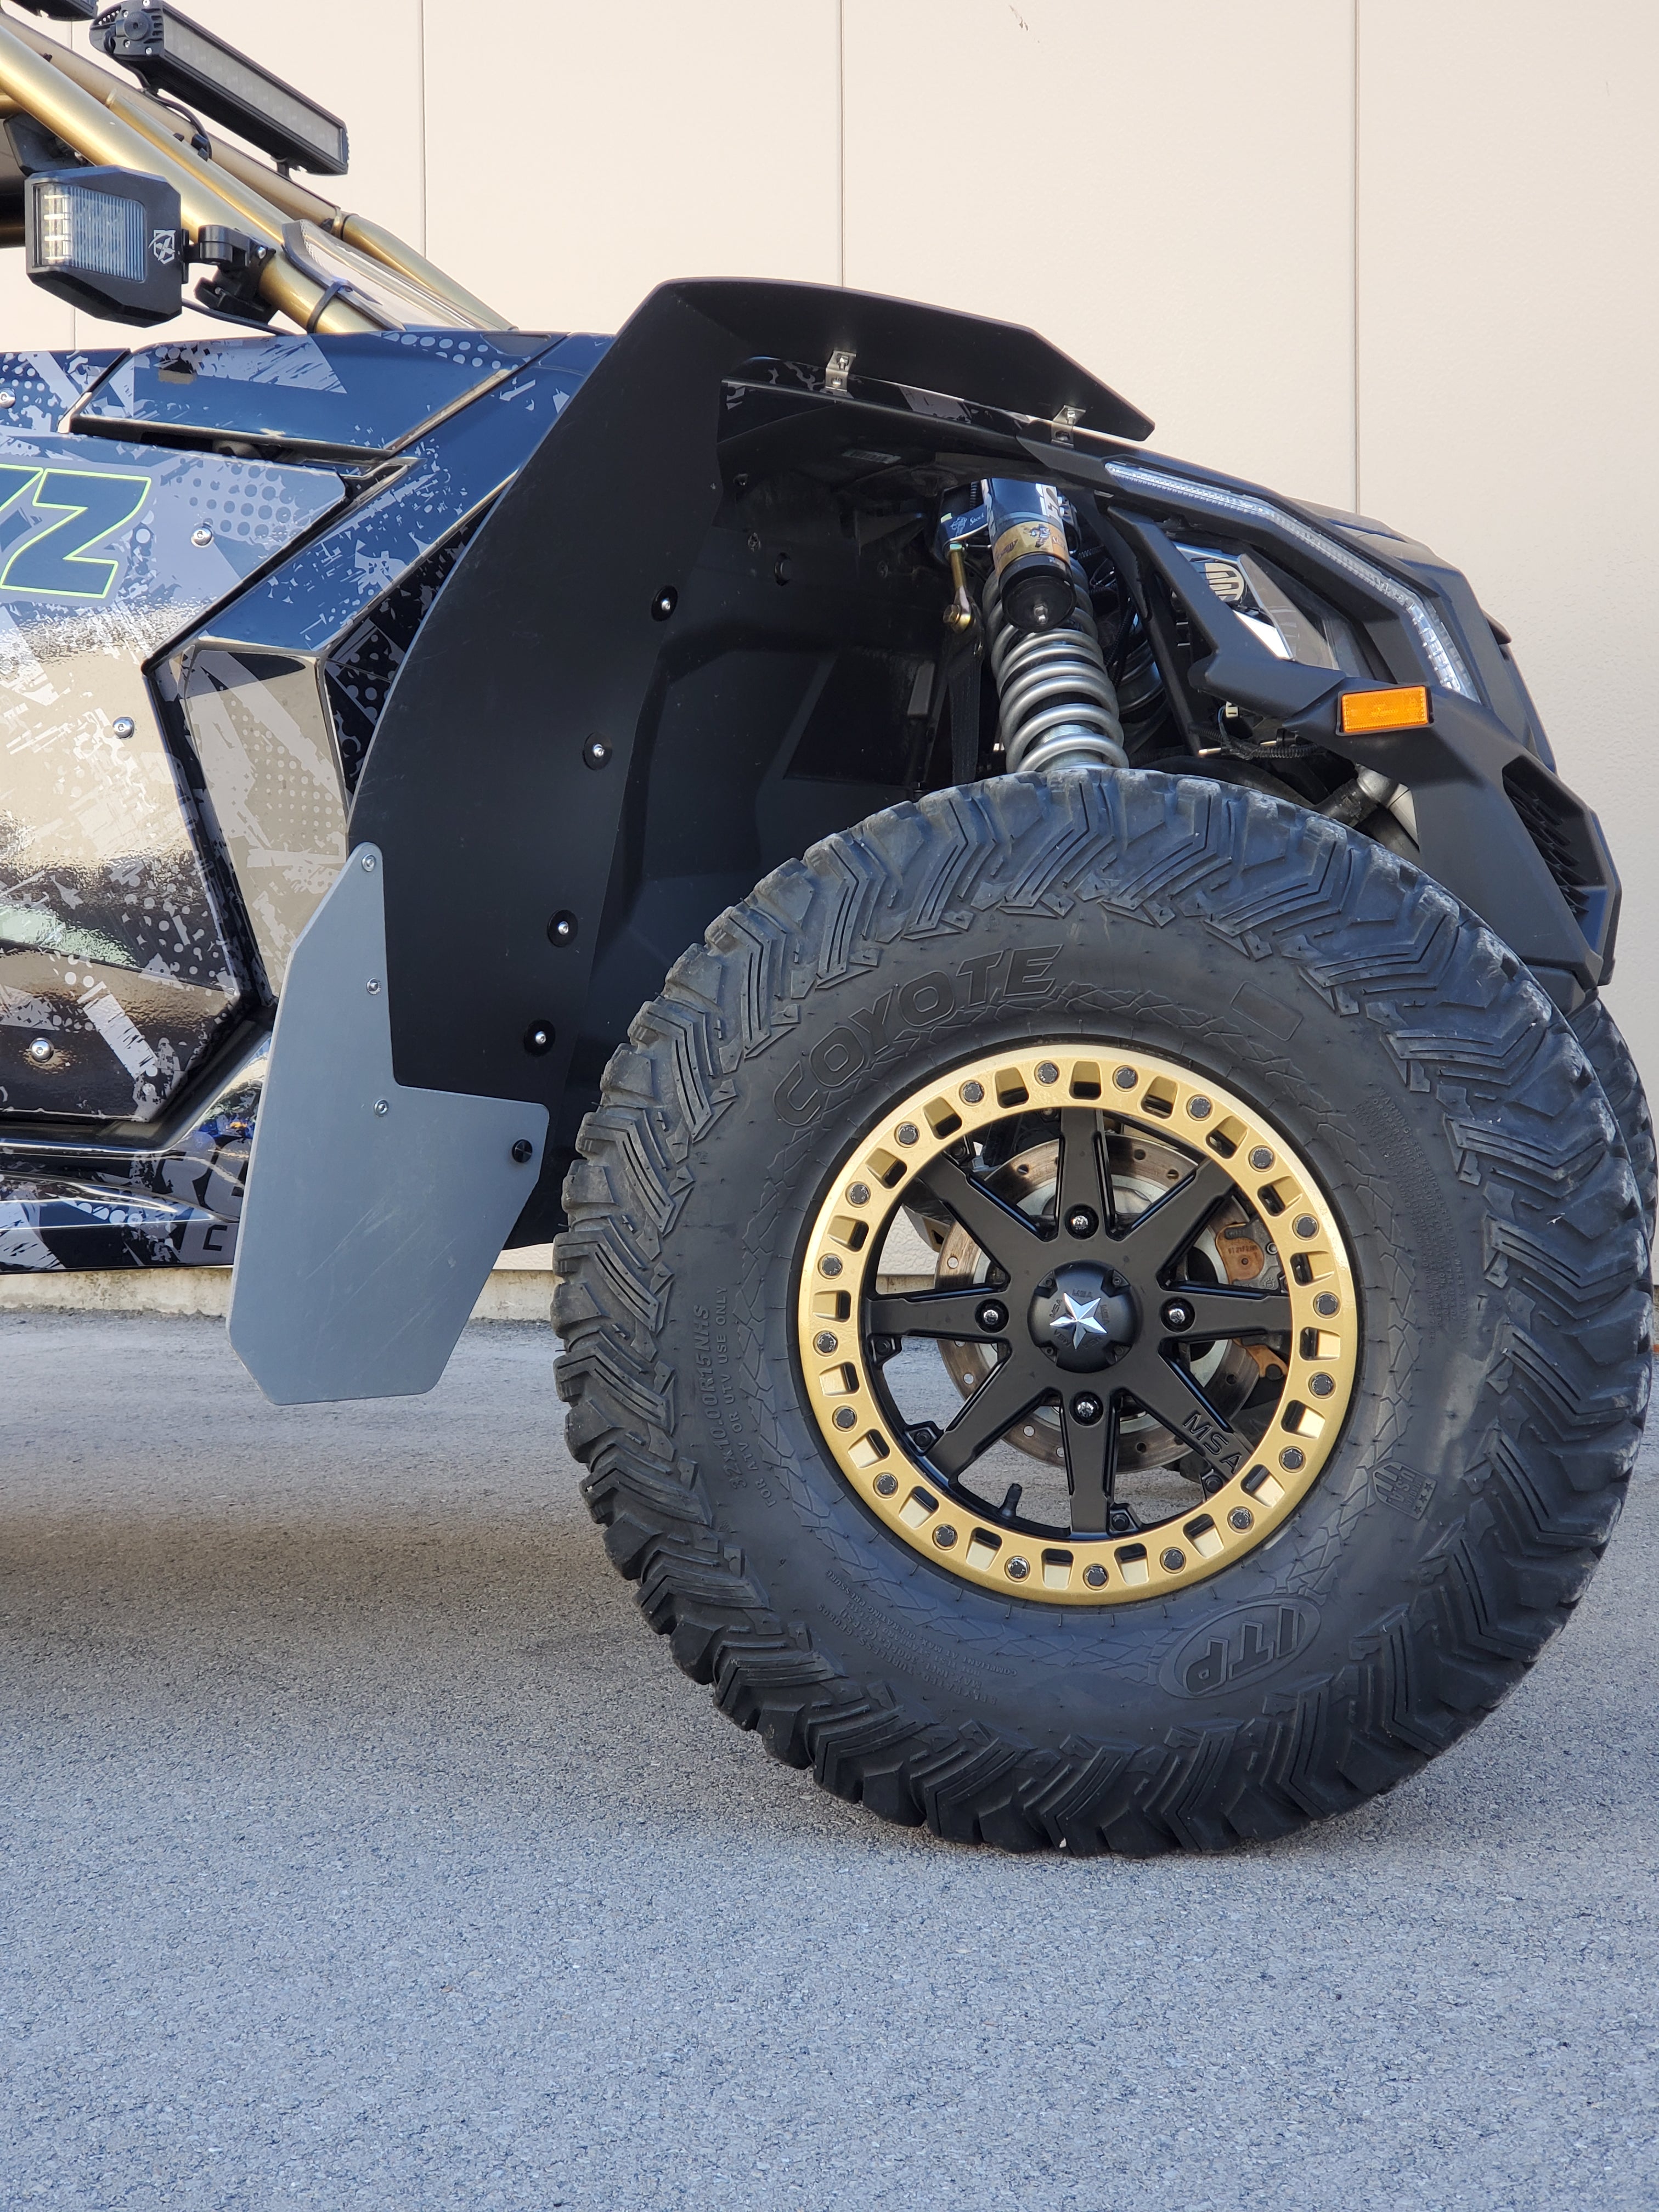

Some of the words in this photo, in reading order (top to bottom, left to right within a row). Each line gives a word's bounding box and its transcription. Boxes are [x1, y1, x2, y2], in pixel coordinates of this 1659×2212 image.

[772, 944, 1063, 1126] COYOTE
[1368, 1092, 1384, 1111] FOR
[1381, 1110, 1415, 1163] OPERATING
[1375, 1086, 1414, 1138] WARNING:
[1410, 1139, 1424, 1157] SEE
[1420, 1158, 1442, 1200] VEHICLE
[1449, 1235, 1457, 1248] OR
[714, 1285, 728, 1325] ONLY
[716, 1334, 729, 1364] USE
[720, 1373, 735, 1405] UTV
[727, 1410, 743, 1434] OR
[737, 1439, 758, 1473] ATV
[1183, 1412, 1243, 1474] MSA
[753, 1477, 776, 1508] FOR
[1389, 1470, 1415, 1503] U.S.A.
[824, 1568, 867, 1608] PRESSURE
[865, 1604, 917, 1641] OPERATING
[945, 1650, 959, 1660] AT
[1183, 1605, 1299, 1696] ITP
